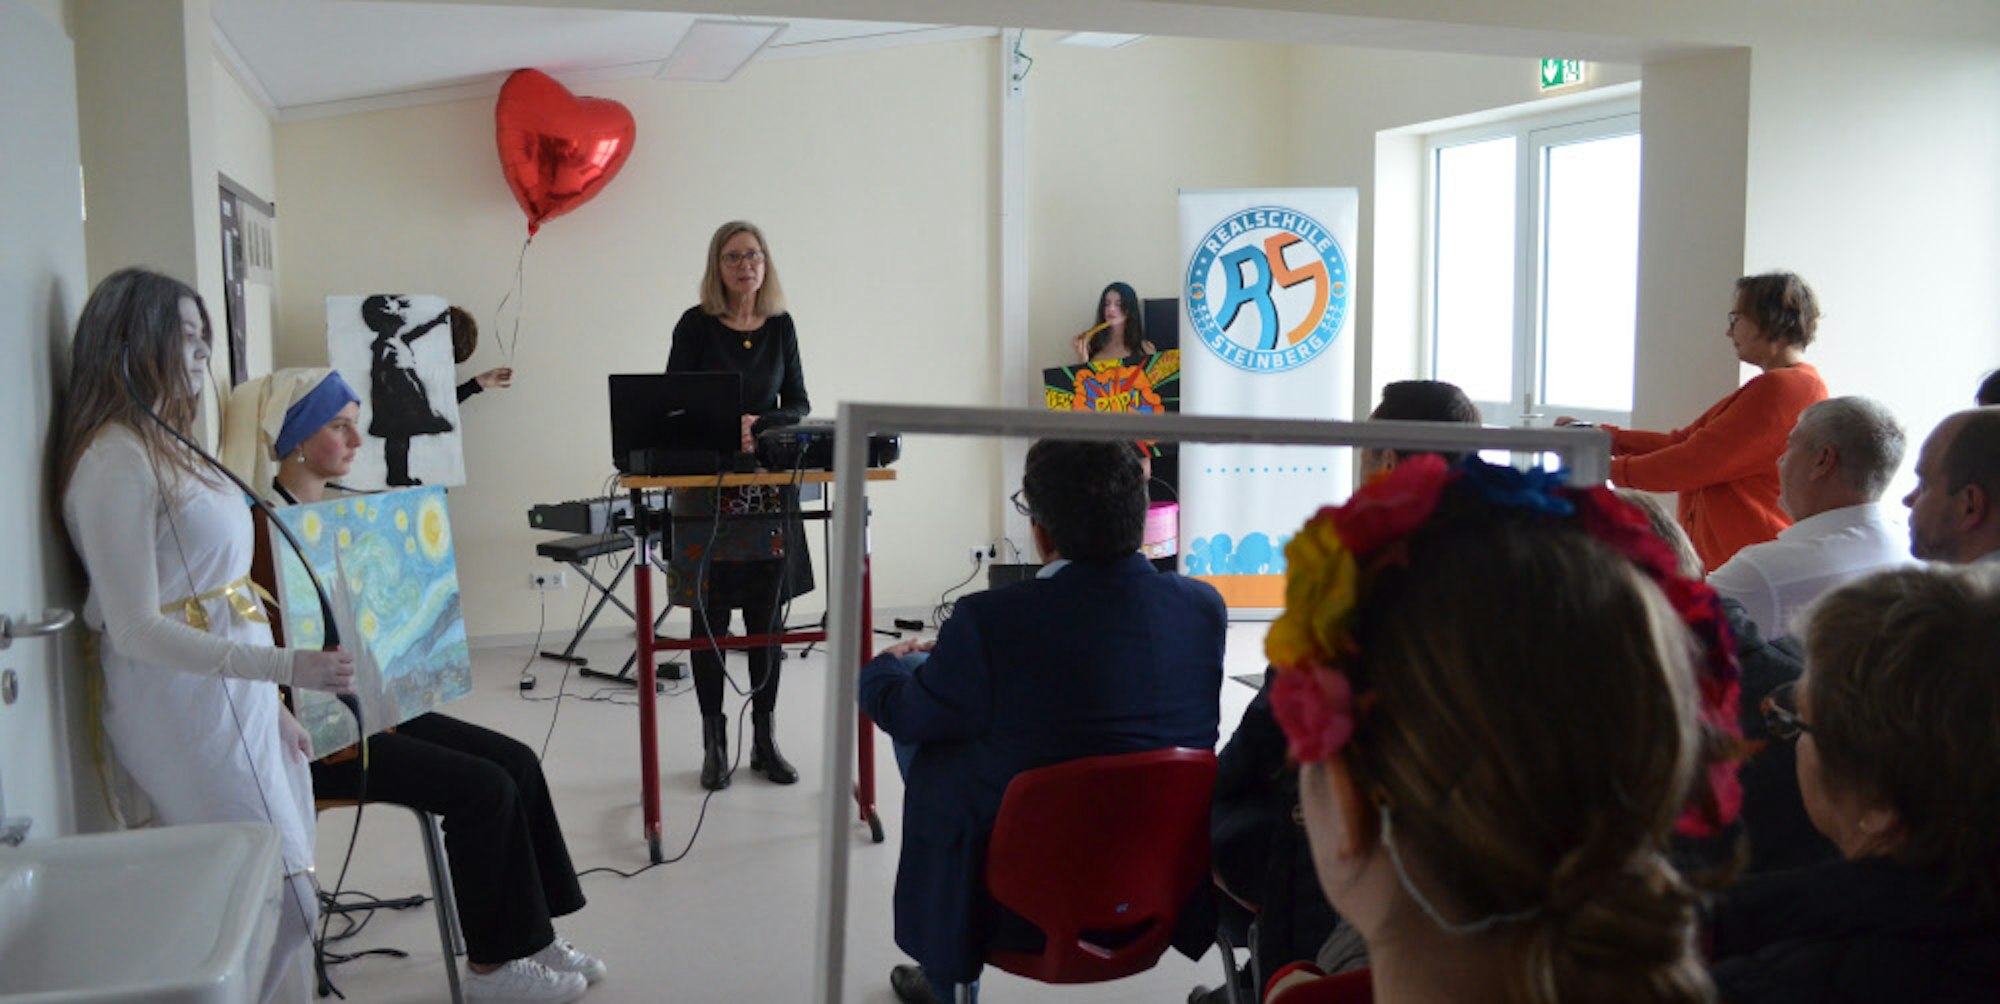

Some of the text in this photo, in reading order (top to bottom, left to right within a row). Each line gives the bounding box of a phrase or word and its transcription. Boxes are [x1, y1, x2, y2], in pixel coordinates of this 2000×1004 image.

[1206, 211, 1332, 254] REALSCHULE
[1215, 231, 1329, 350] RS
[1211, 334, 1324, 369] STEINBERG
